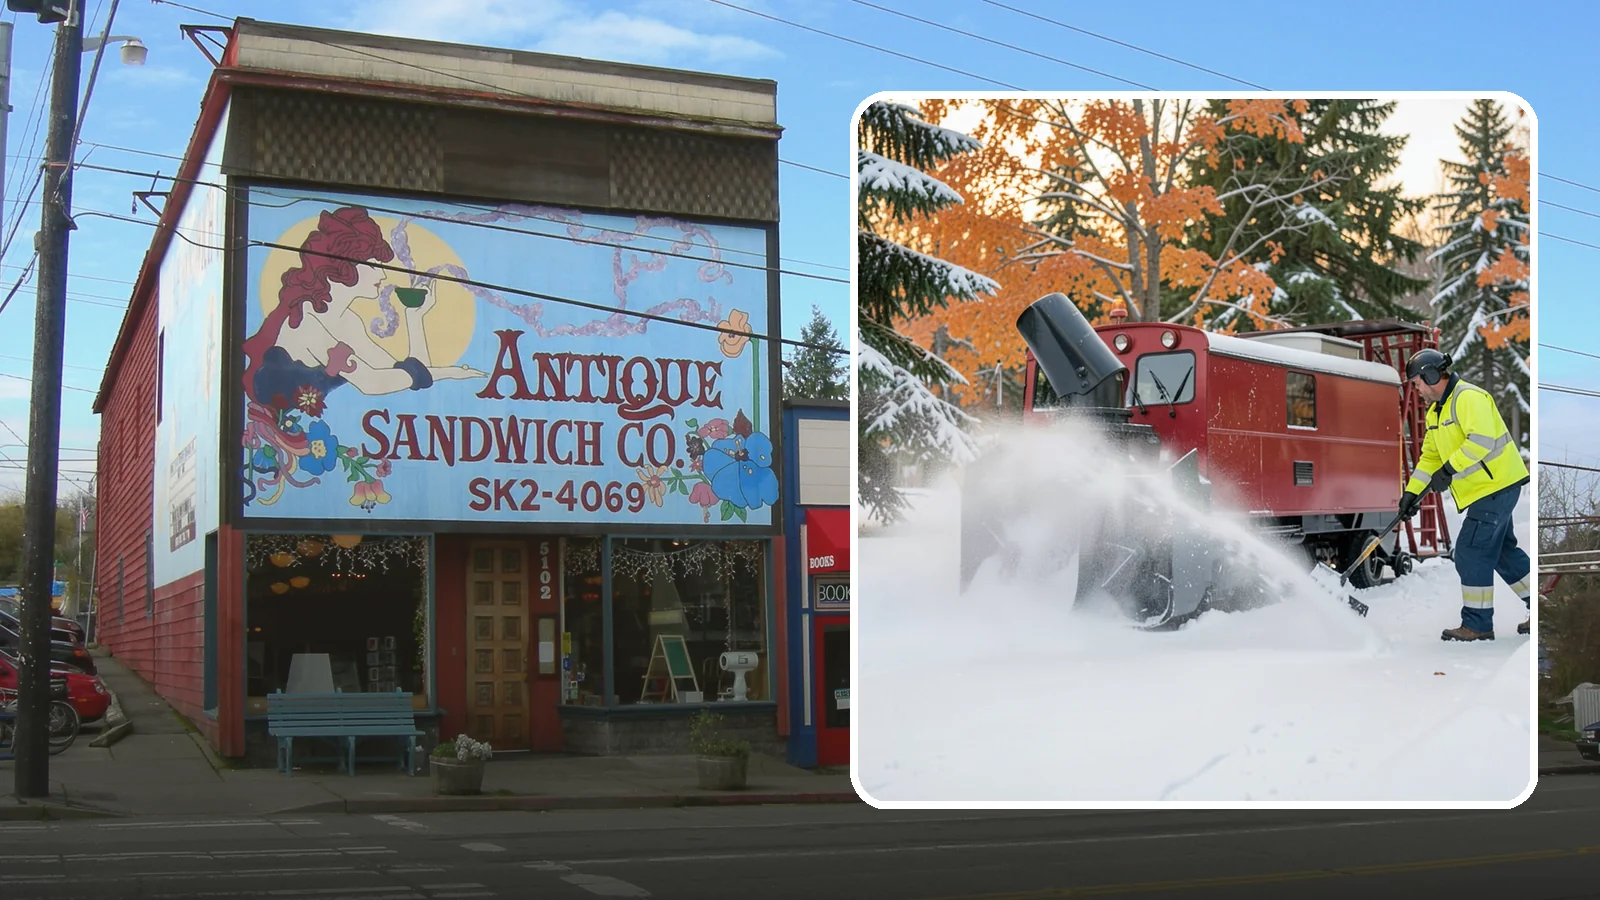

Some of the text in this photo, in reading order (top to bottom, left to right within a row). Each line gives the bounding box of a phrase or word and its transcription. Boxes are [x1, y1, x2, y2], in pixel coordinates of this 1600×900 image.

[476, 328, 724, 421] ANTIQUE
[361, 408, 685, 469] SANDWICH CO.
[468, 477, 646, 513] SK2-4069
[539, 541, 552, 600] 5102
[809, 555, 835, 569] BOOKS
